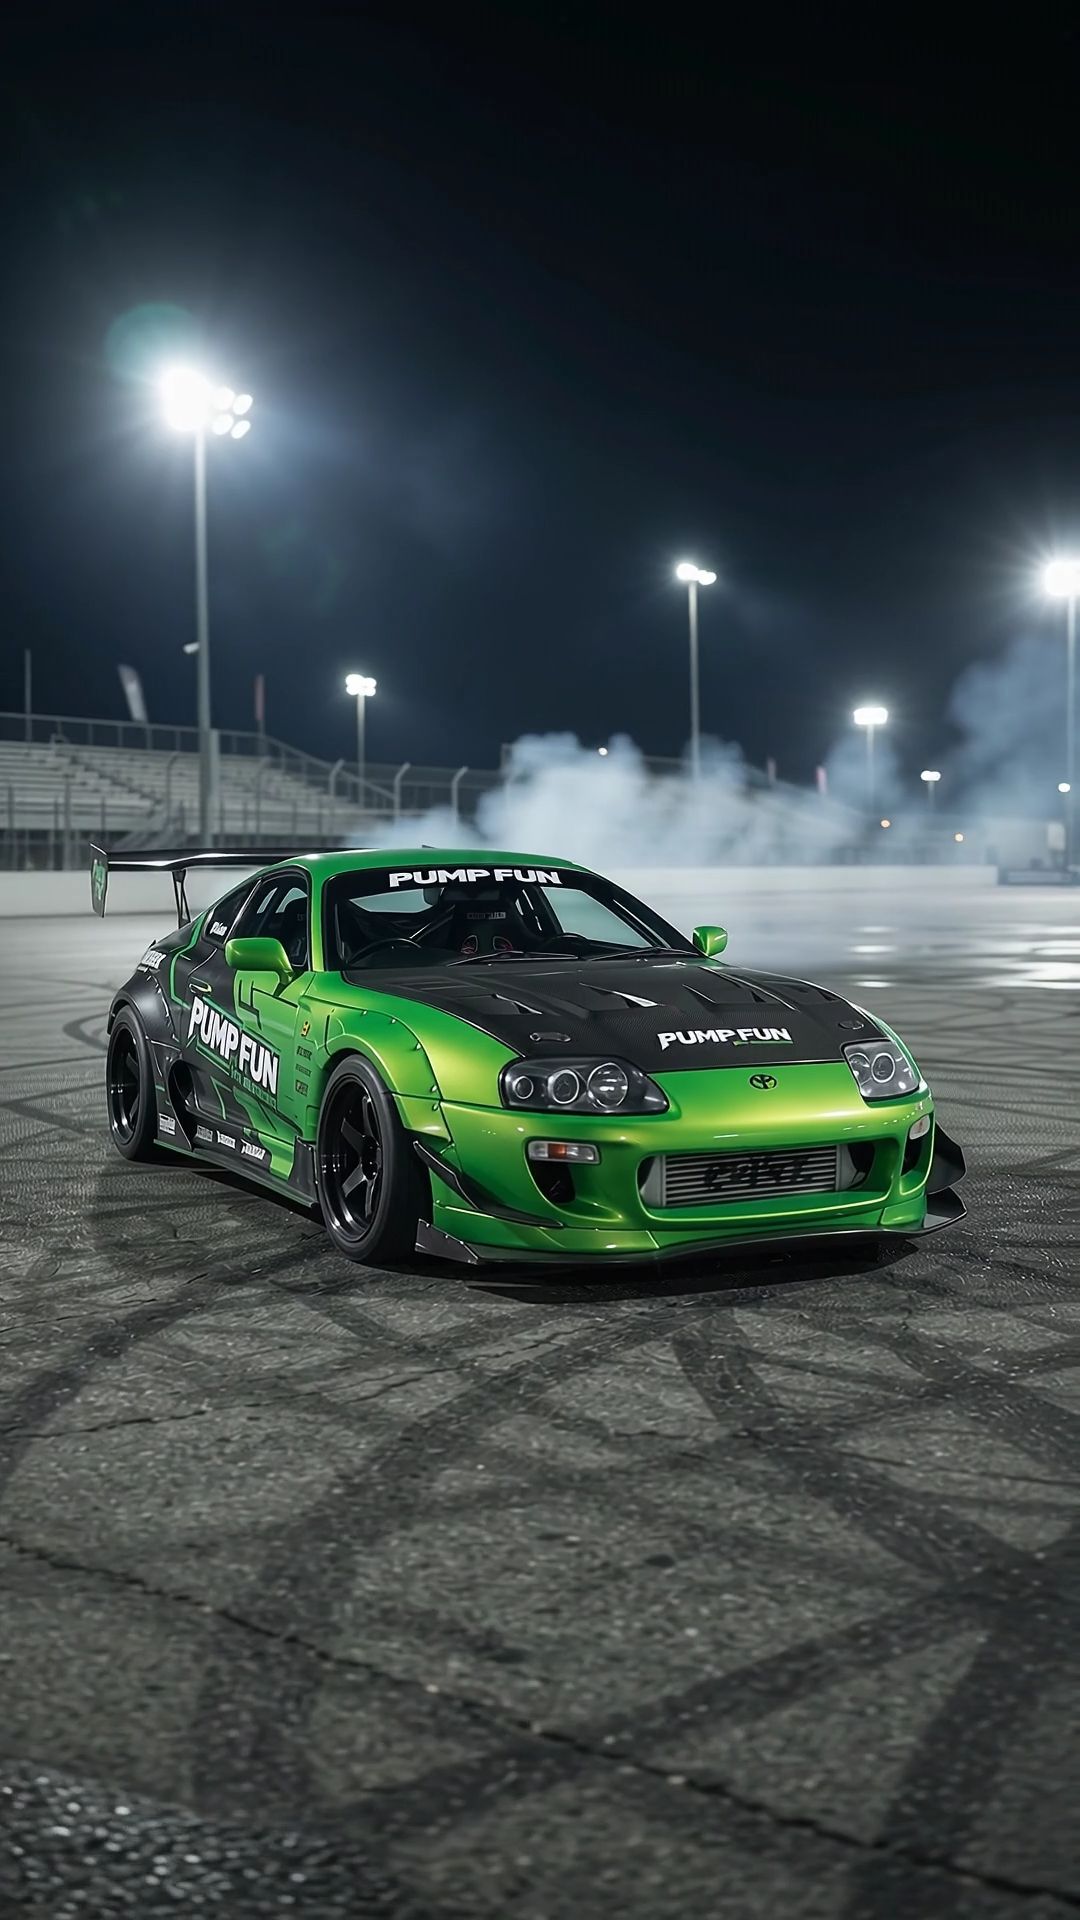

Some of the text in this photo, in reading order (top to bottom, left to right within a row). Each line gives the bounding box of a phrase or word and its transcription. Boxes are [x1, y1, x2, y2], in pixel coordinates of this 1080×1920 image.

[389, 869, 563, 888] PUMP FUN
[187, 996, 239, 1060] PUMP
[238, 1032, 279, 1095] FUN
[657, 1027, 793, 1050] PUMP FUN
